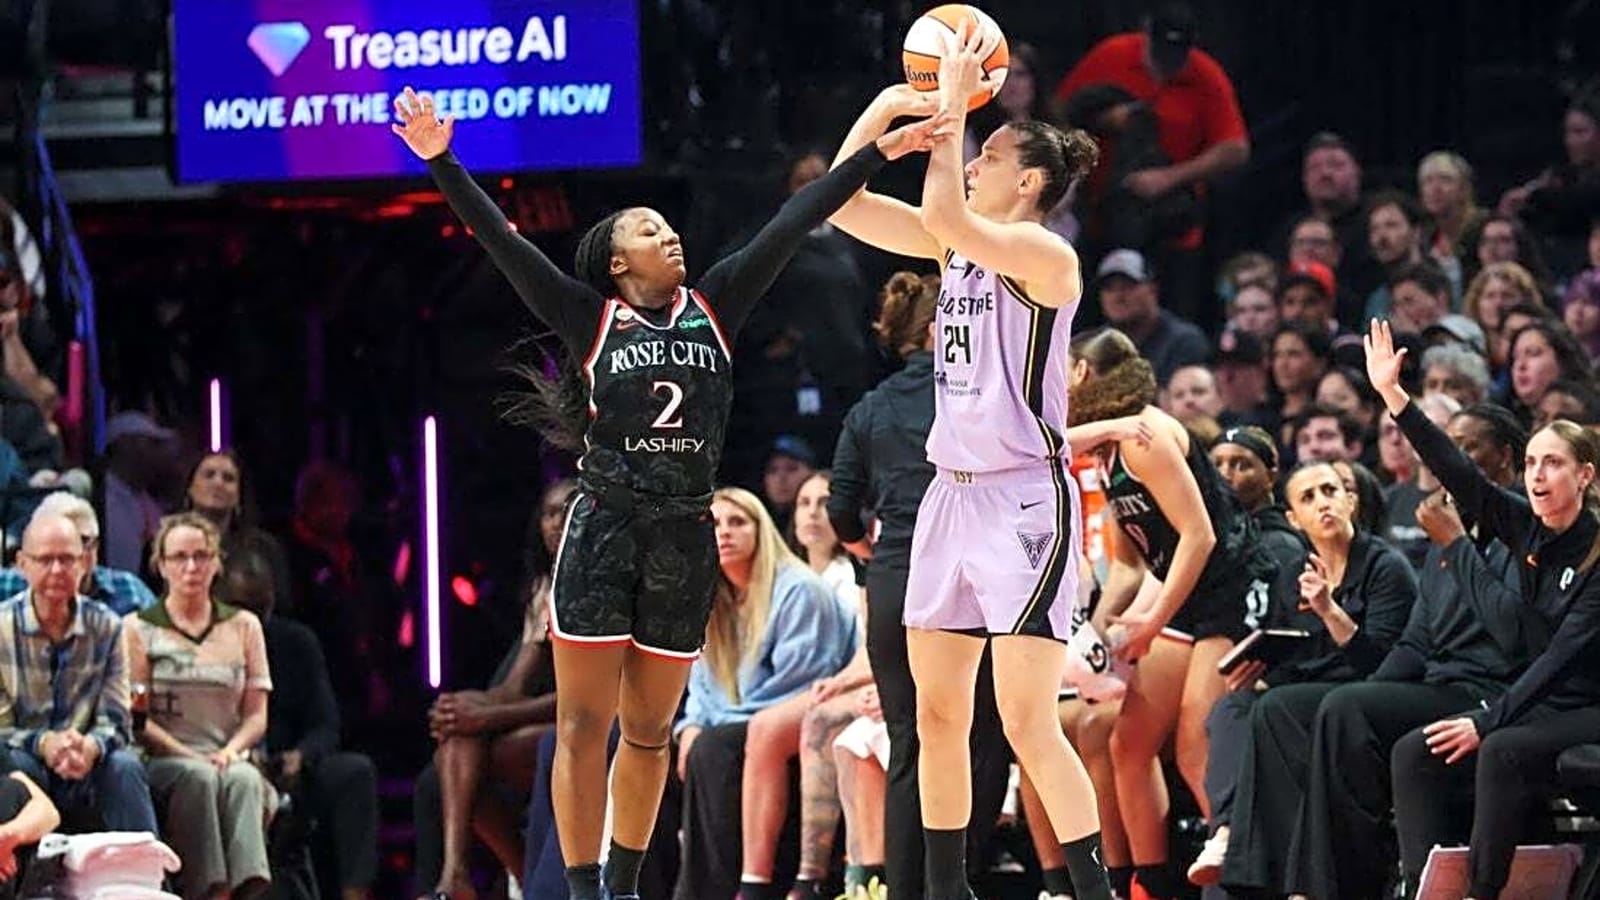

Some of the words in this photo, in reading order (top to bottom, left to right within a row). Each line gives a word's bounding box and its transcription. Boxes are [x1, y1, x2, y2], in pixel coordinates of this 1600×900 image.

[324, 24, 513, 70] Treasure
[516, 15, 566, 62] AI
[907, 64, 938, 82] lson
[204, 96, 286, 131] MOVE
[290, 94, 328, 127] AT
[331, 92, 390, 125] THE
[394, 88, 489, 122] EED
[494, 86, 534, 118] OF
[538, 83, 611, 116] NOW
[609, 341, 666, 374] ROSE
[671, 341, 717, 373] CITY
[944, 325, 972, 364] 24
[651, 380, 684, 429] 2
[625, 437, 705, 453] LASHIFY
